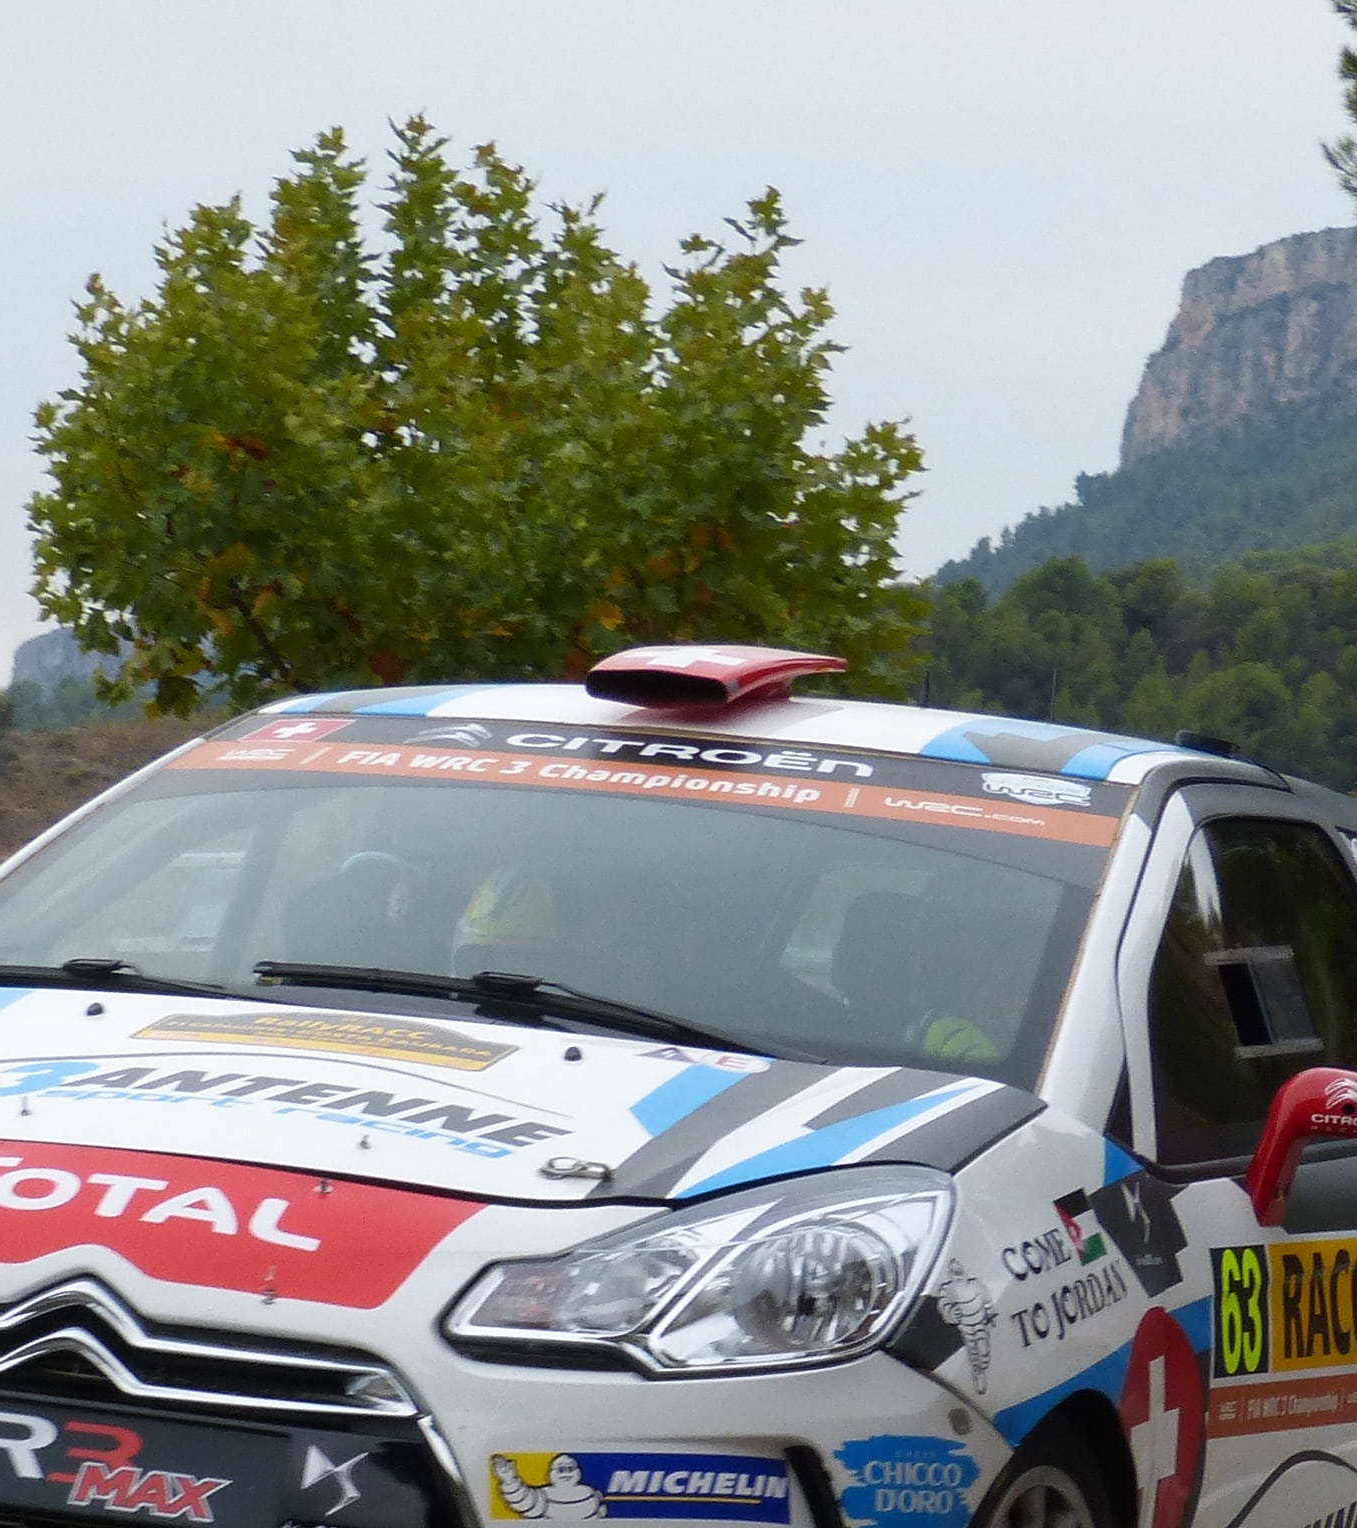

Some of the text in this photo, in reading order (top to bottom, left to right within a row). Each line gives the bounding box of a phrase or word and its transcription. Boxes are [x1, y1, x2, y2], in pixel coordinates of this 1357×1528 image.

[337, 750, 402, 766] FIA
[410, 754, 497, 772] WRC
[500, 761, 532, 774] 3
[538, 763, 822, 804] Championship
[506, 733, 874, 778] CITROËN
[36, 1089, 516, 1160] sport racing
[1002, 1228, 1072, 1282] COME
[1010, 1260, 1129, 1348] TO JORDAN
[1219, 1246, 1264, 1375] 63
[67, 1461, 234, 1523] MAX
[605, 1468, 791, 1501] MICHELIN
[864, 1459, 964, 1487] CHICCO
